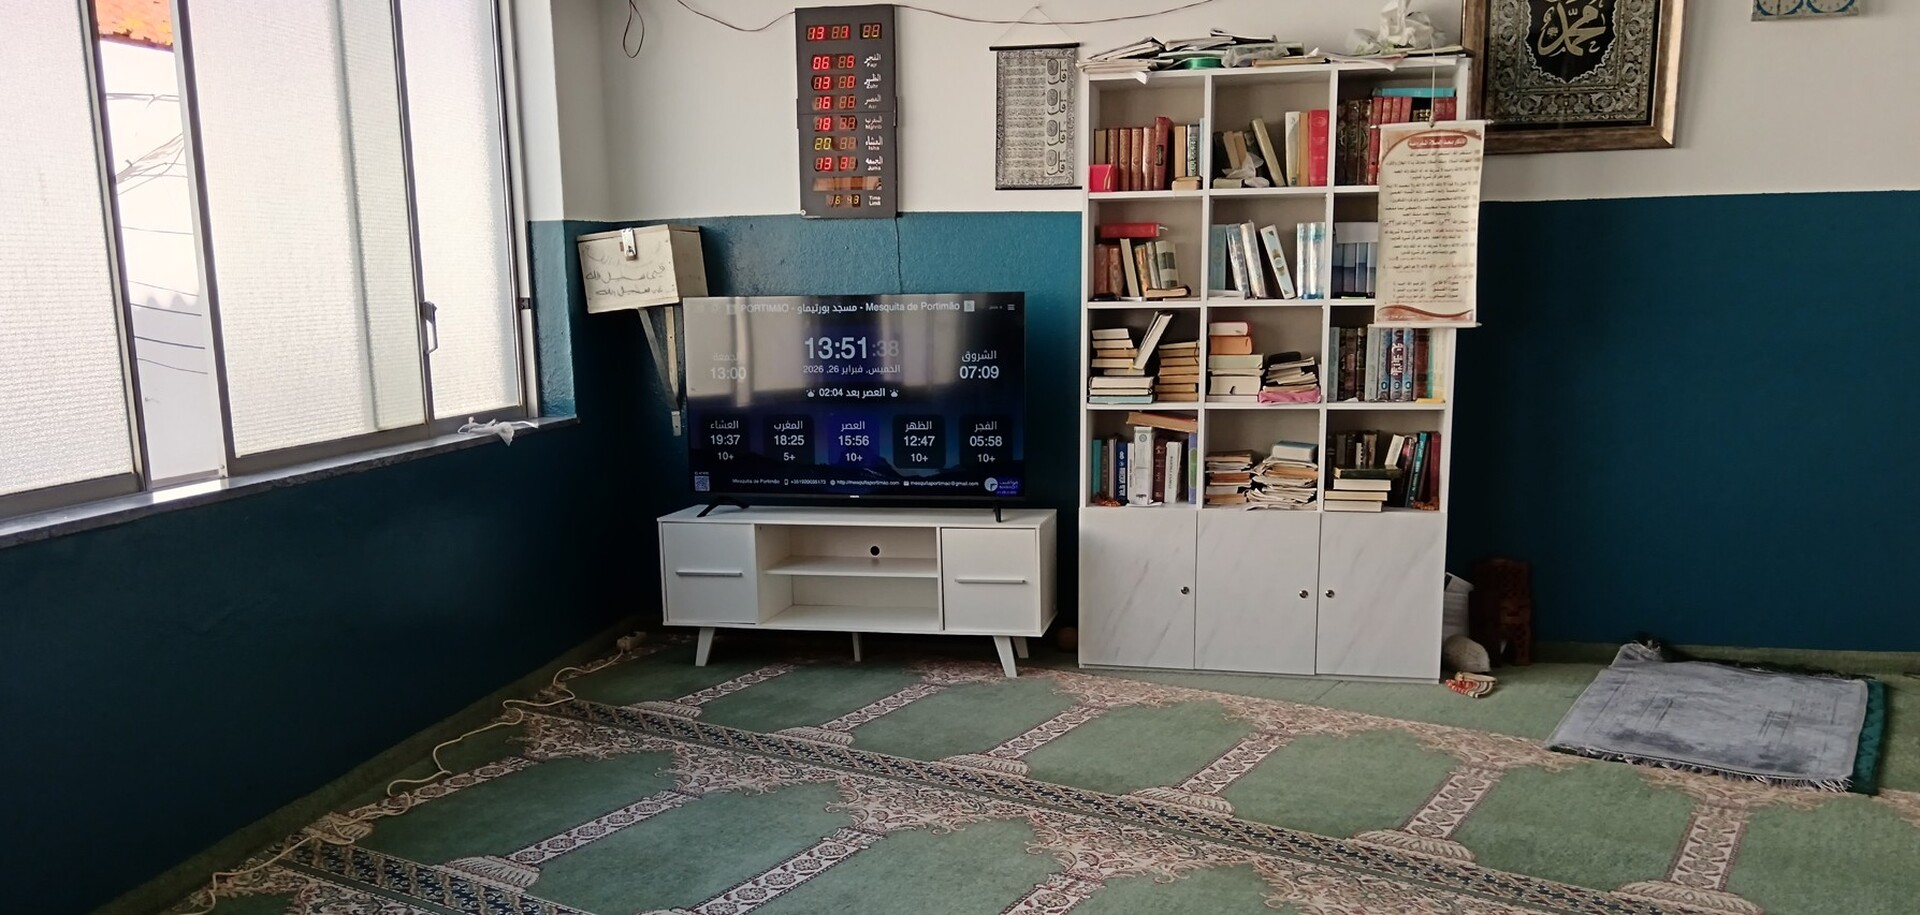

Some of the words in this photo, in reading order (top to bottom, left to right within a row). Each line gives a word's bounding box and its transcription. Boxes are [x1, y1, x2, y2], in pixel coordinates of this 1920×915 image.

[866, 302, 905, 312] Mesquita
[906, 302, 918, 310] de
[920, 302, 960, 311] Portimão
[961, 351, 997, 362] الشروق
[710, 366, 747, 380] 13:00
[803, 366, 824, 374] 2026
[960, 366, 1000, 380] 07:09
[819, 388, 844, 397] 02:04
[846, 389, 860, 398] بعد
[862, 388, 886, 399] العصر
[710, 420, 739, 430] العشاء
[774, 420, 803, 432] المغرب
[840, 420, 866, 432] العصر
[904, 420, 932, 432] الظهر
[974, 420, 998, 432] الفجر
[710, 434, 741, 446] 19:37
[774, 434, 804, 446] 18:25
[838, 435, 870, 447] 15:56
[904, 436, 936, 447] 12:47
[969, 436, 1002, 447] 05:58
